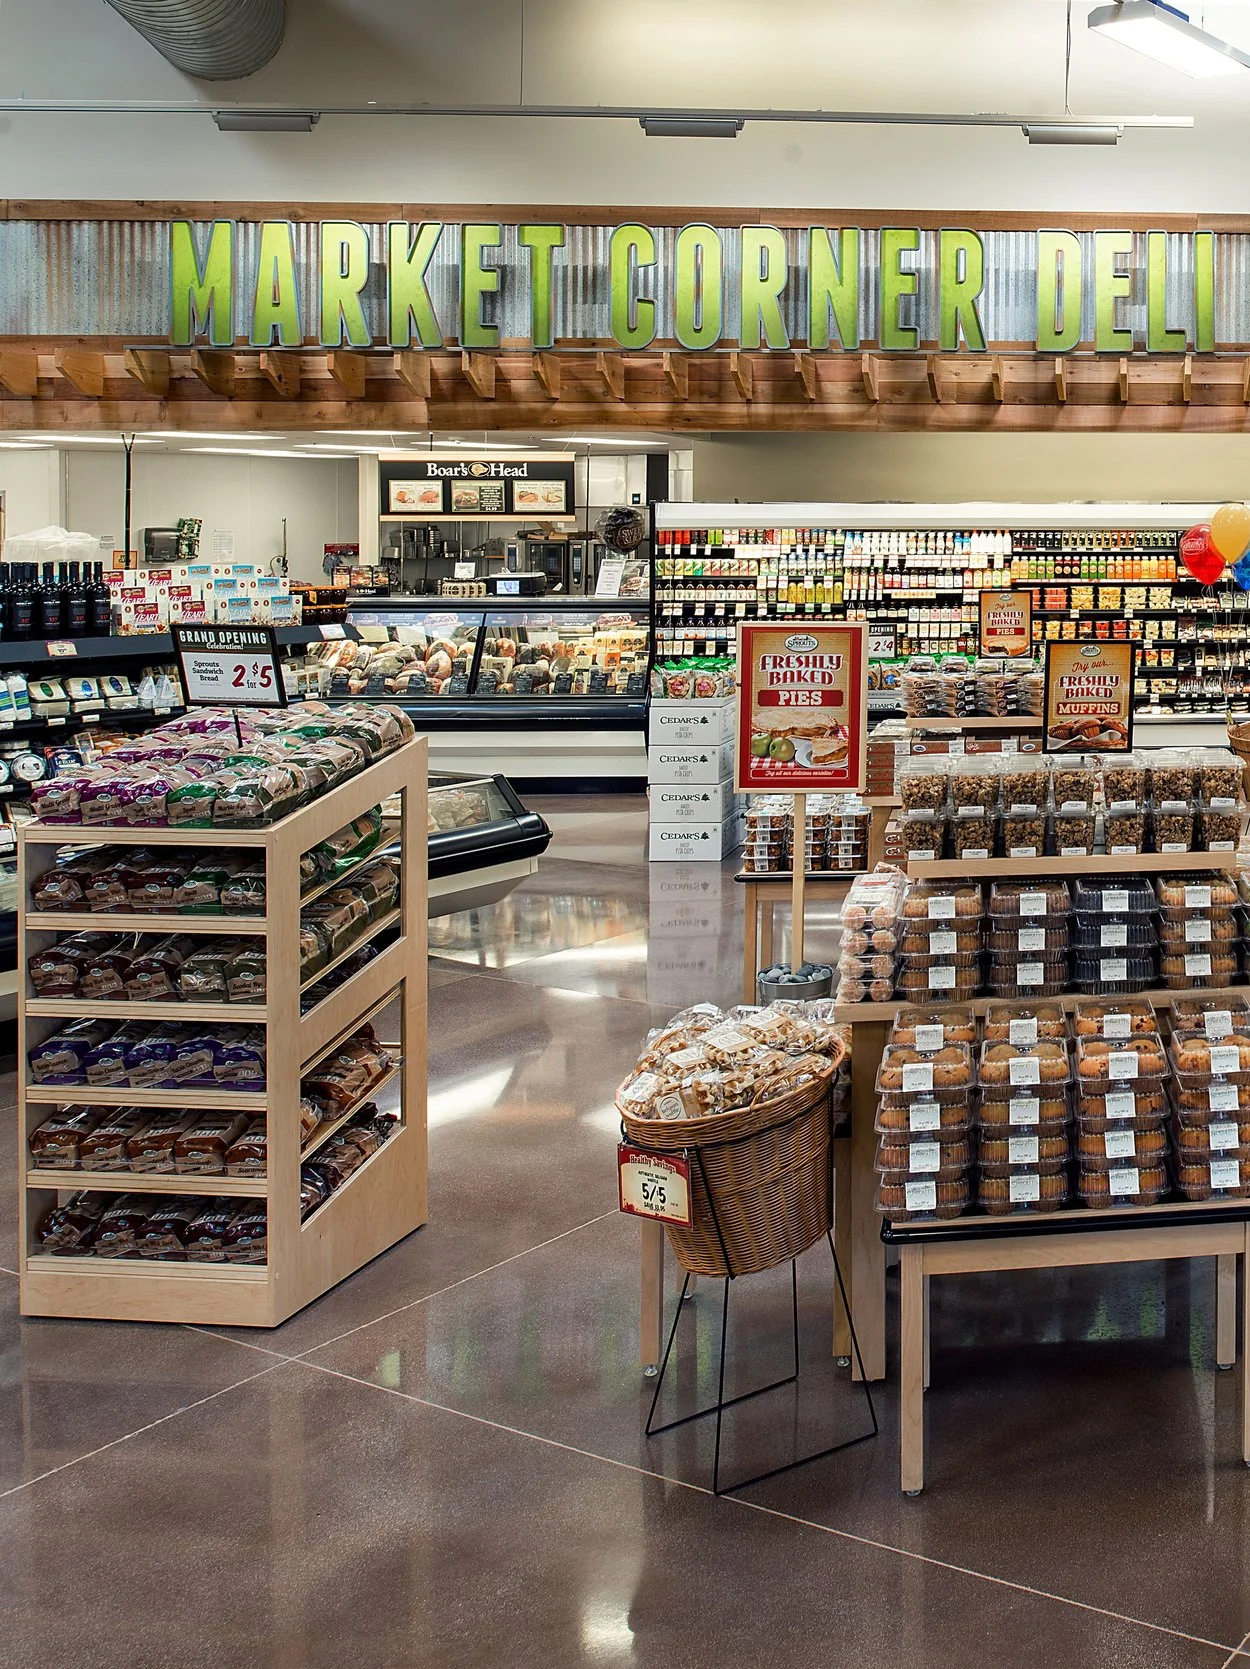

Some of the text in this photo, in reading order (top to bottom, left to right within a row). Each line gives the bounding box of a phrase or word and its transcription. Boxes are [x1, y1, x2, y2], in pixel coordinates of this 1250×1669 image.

[169, 218, 1216, 352] MARKET CORNER DELI
[427, 462, 528, 477] Boar's Head
[987, 611, 1024, 619] FRESHLY
[991, 618, 1021, 627] BAKED
[180, 630, 267, 645] GRAND OPENING
[787, 639, 816, 648] SPROUTS
[206, 642, 244, 650] Celebration!
[873, 641, 881, 652] 2
[760, 654, 843, 671] FRESHLY
[1072, 662, 1089, 673] Try
[232, 664, 246, 688] 2
[246, 680, 257, 688] for
[768, 670, 835, 687] BAKED
[1058, 675, 1120, 688] FRESHLY
[778, 690, 823, 706] PIES
[1064, 687, 1113, 700] BAKED
[1058, 703, 1119, 715] MUFFINS
[660, 716, 700, 725] CEDAR'S
[659, 754, 699, 763] CEDAR'S
[661, 793, 701, 802] CEDAR'S
[660, 832, 700, 841] CEDAR'S
[629, 1154, 677, 1175] Healthy Savings
